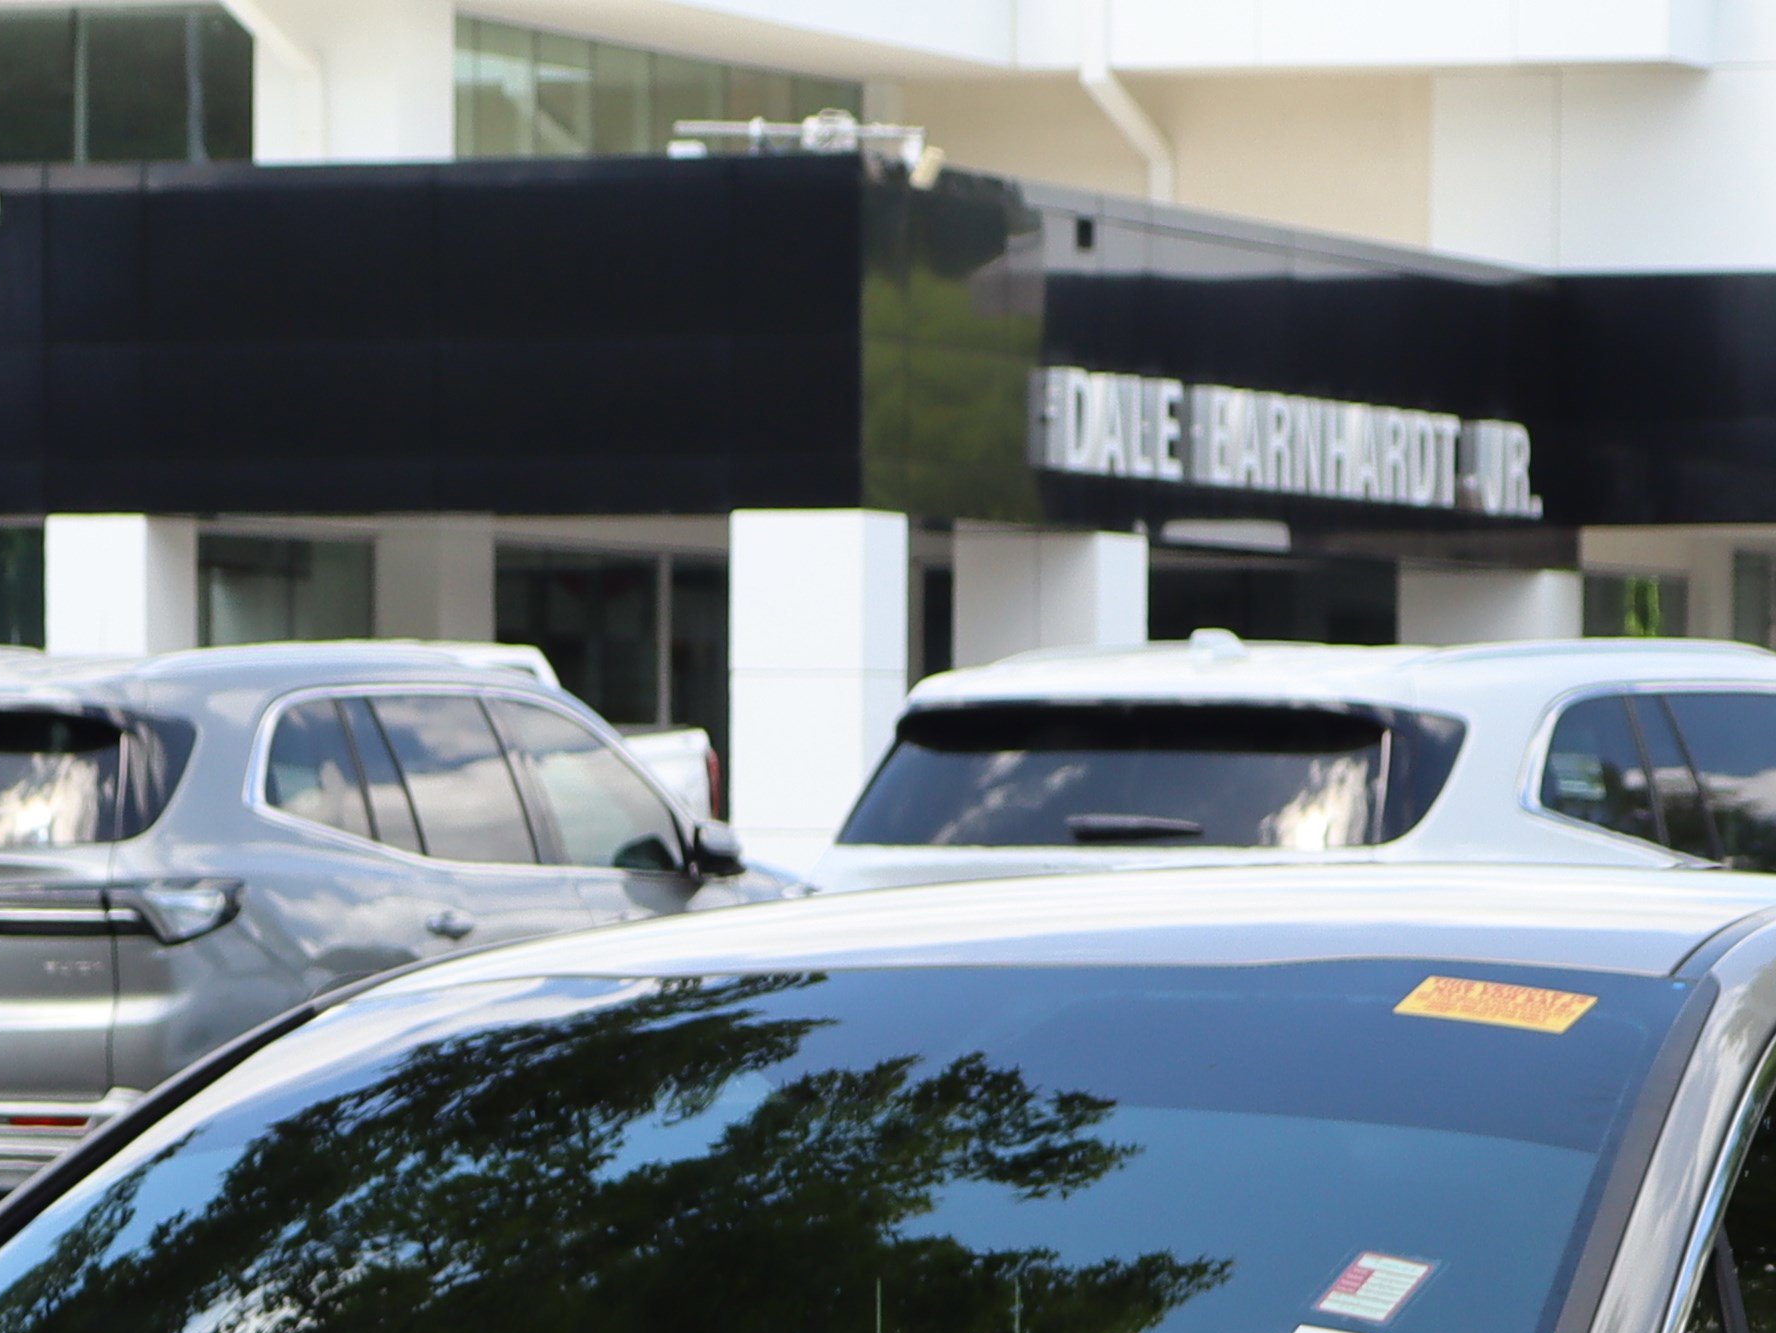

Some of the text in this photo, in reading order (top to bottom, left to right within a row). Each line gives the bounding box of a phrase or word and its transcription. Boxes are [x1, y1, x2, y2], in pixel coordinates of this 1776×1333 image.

[1040, 365, 1544, 520] DALE EARNHARDT JR.
